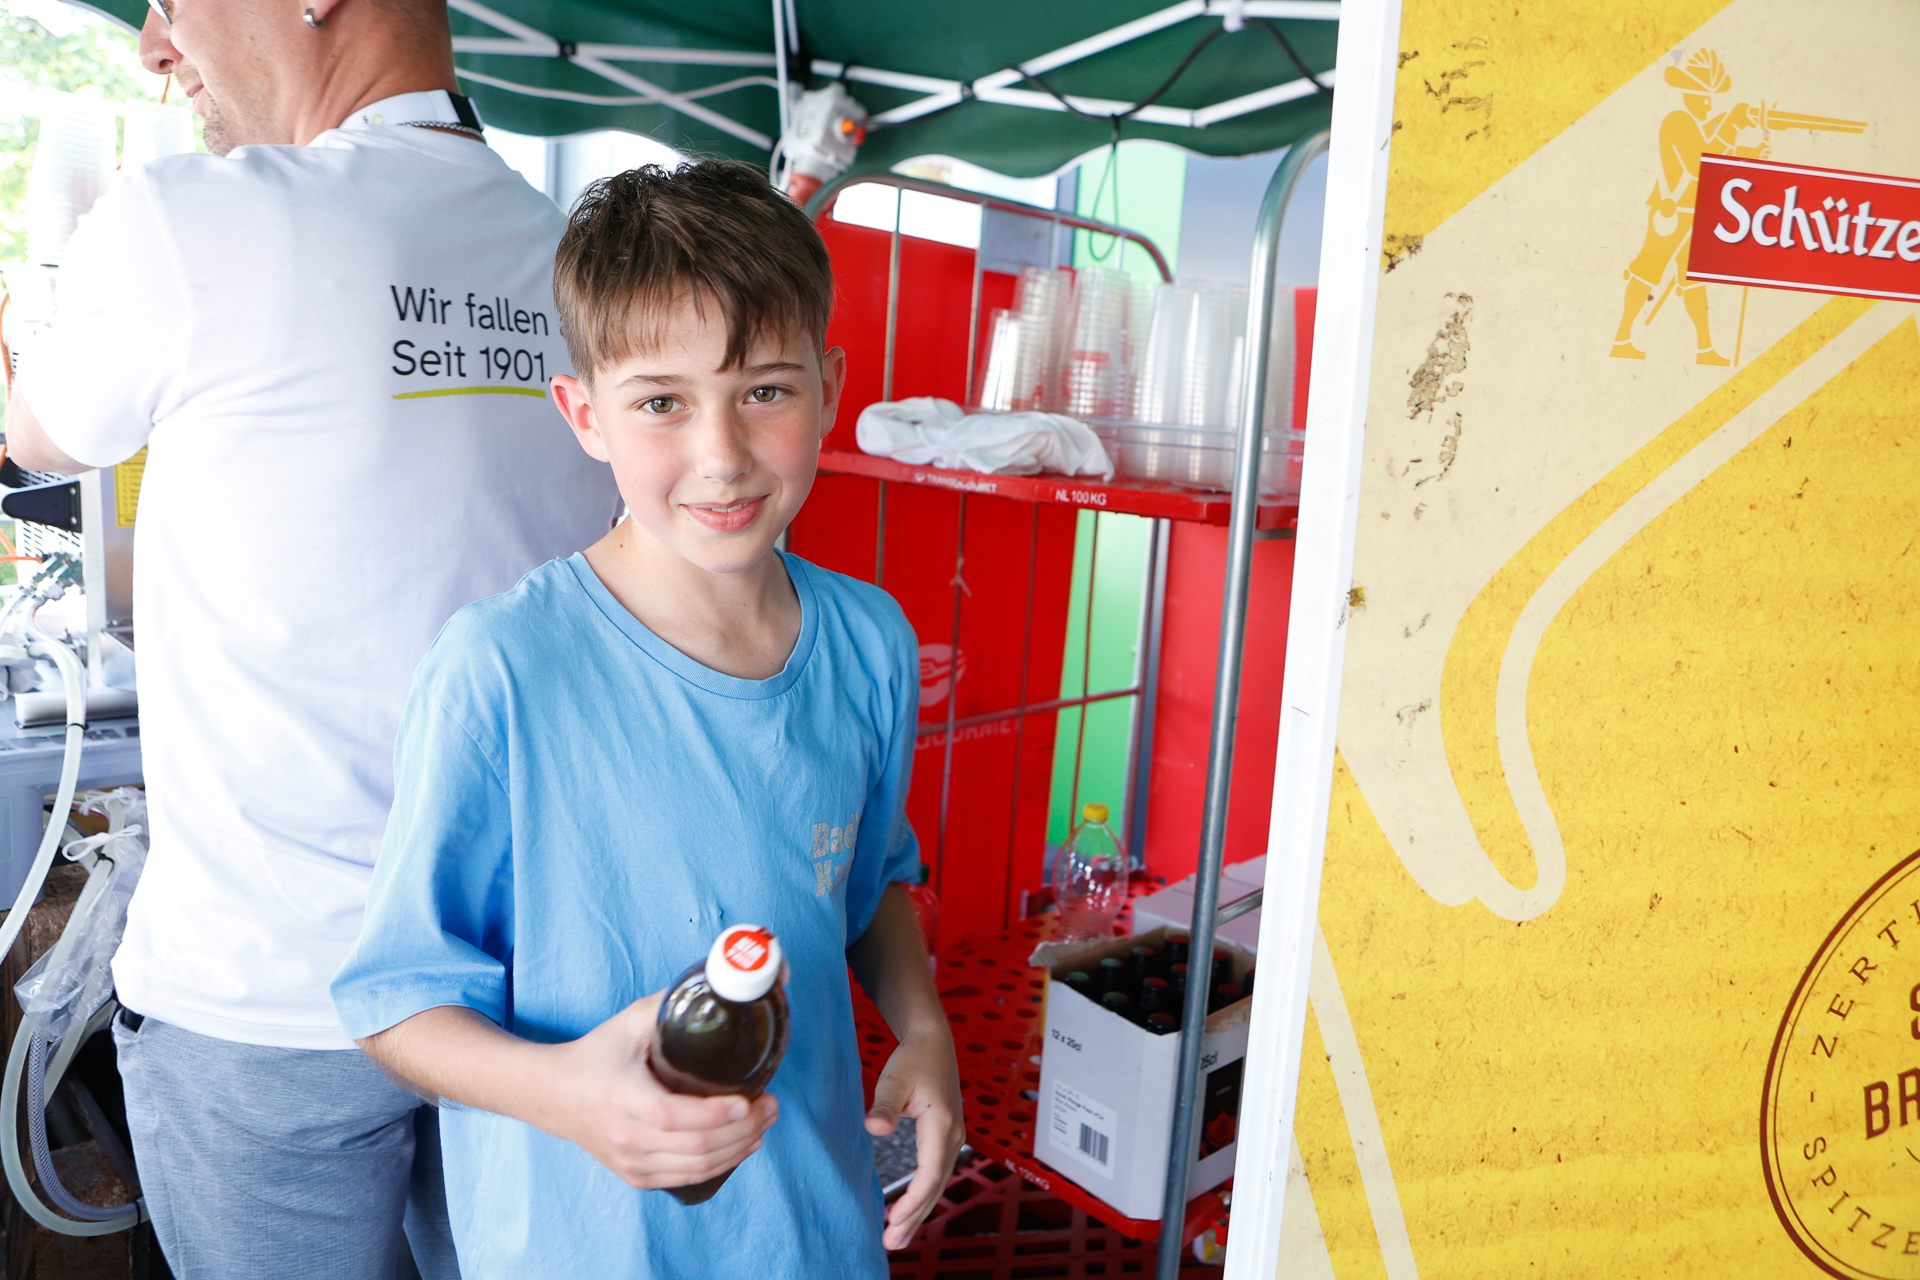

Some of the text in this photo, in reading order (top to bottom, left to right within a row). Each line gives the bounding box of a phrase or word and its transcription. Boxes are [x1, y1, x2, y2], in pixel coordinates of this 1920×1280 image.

[1713, 178, 1920, 262] Schütze
[391, 284, 549, 336] Wir fallen
[392, 340, 467, 377] Seit
[1055, 489, 1070, 502] NL
